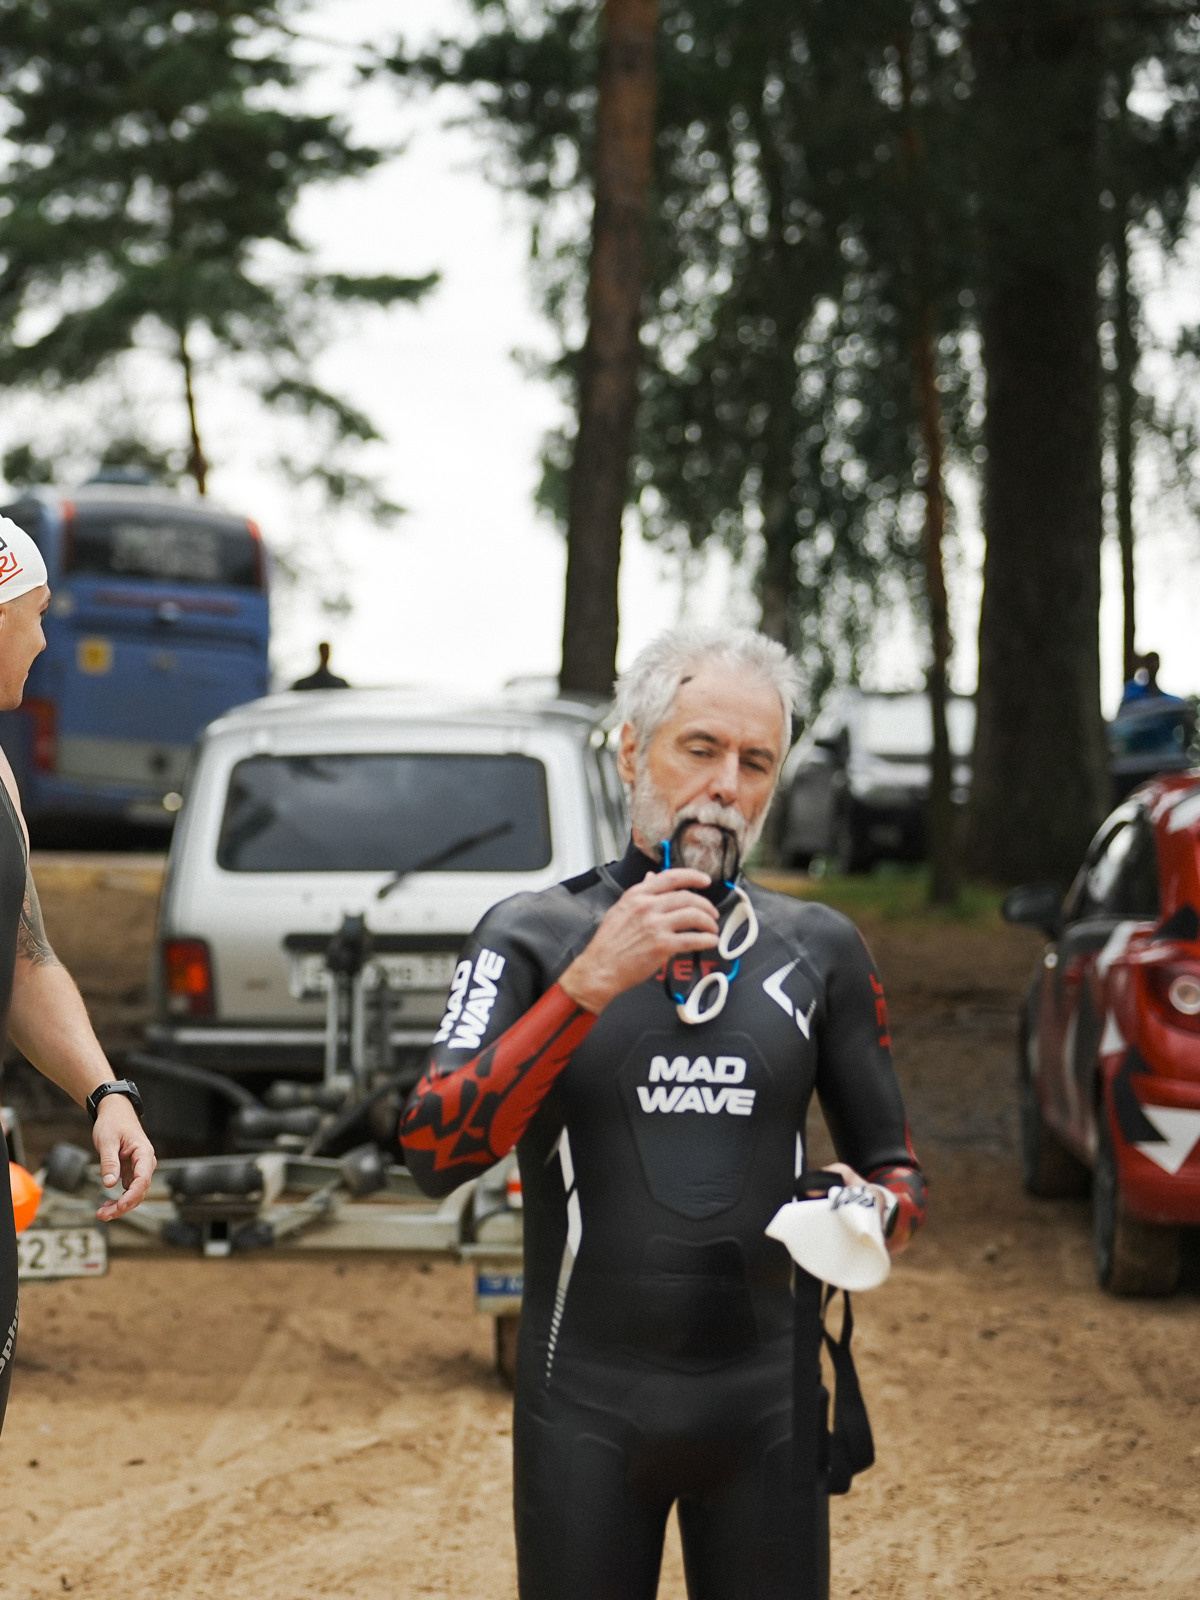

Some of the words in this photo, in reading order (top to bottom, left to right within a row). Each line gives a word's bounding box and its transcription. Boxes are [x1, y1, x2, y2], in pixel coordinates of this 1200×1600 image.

[656, 959, 718, 981] JET
[432, 960, 473, 1044] MAD
[447, 948, 506, 1049] WAVE
[648, 1055, 747, 1084] MAD
[636, 1086, 756, 1116] WAVE
